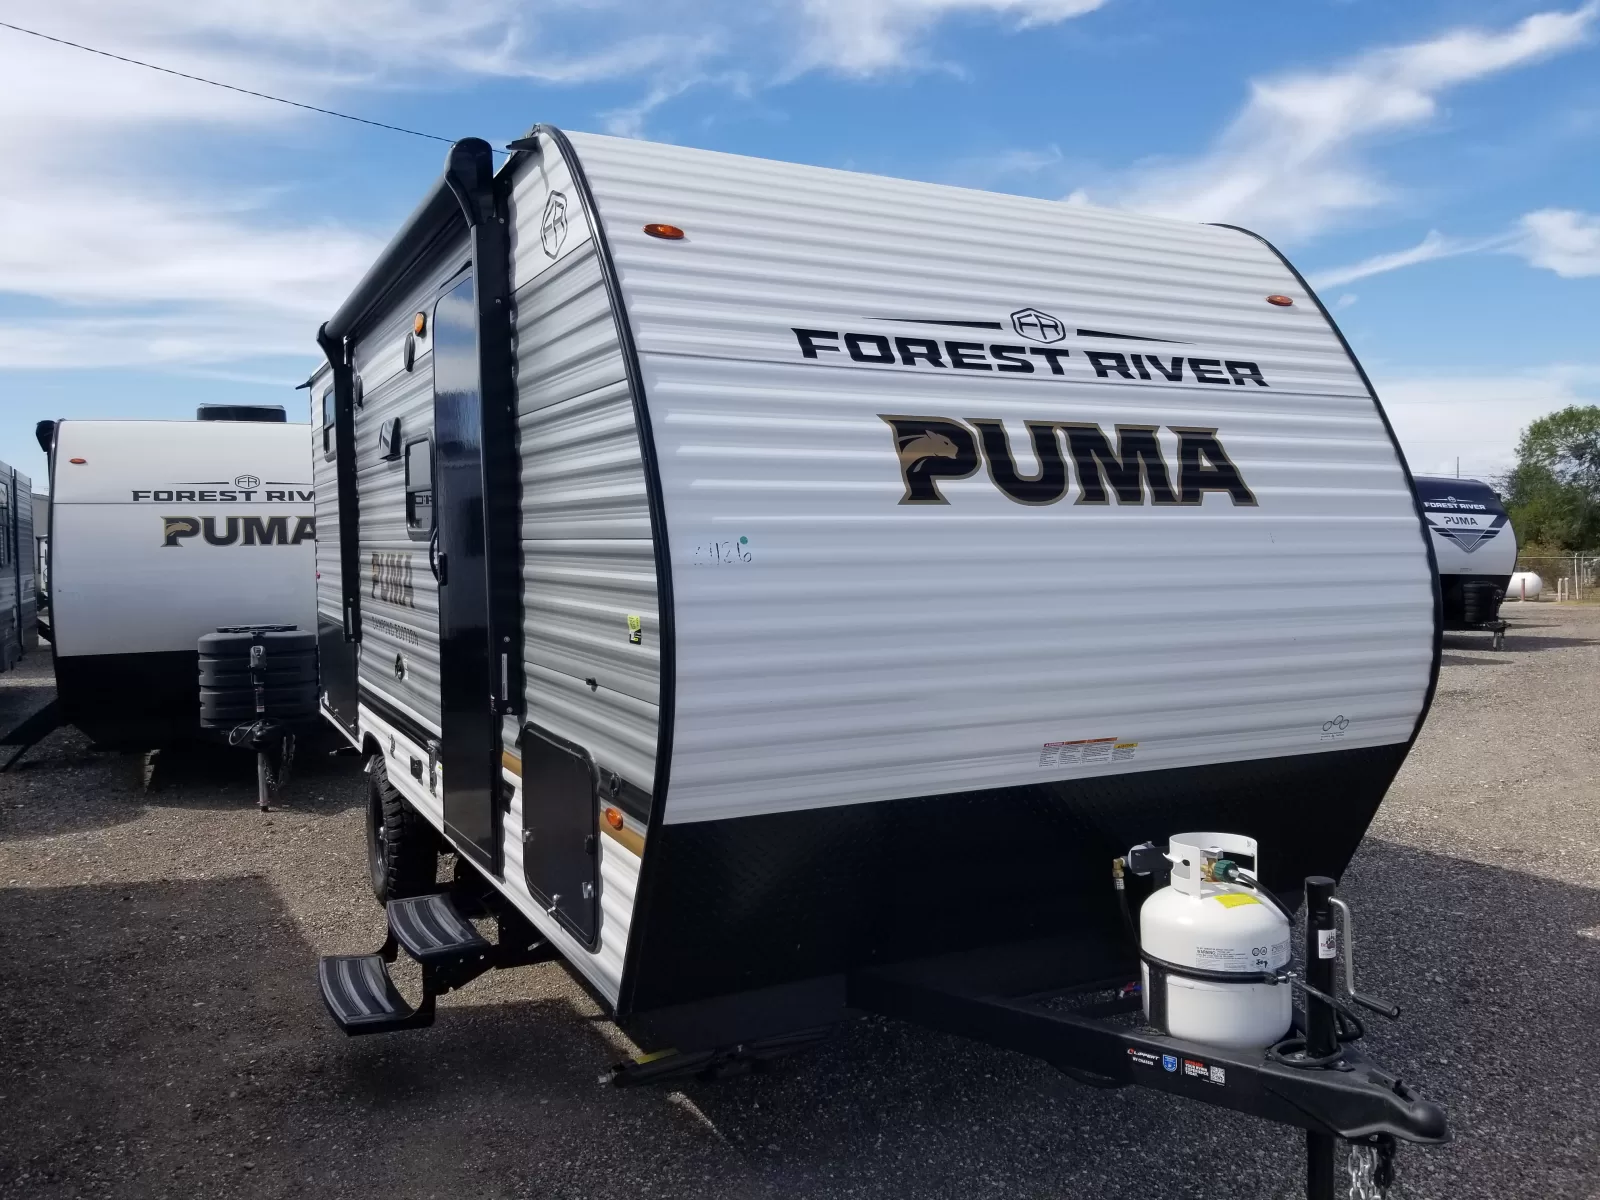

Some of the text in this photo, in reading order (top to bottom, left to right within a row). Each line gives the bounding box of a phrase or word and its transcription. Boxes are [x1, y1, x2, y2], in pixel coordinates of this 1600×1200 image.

[791, 327, 1270, 387] FOREST RIVER
[876, 413, 1260, 507] PUMA
[132, 490, 257, 501] FOREST
[1444, 516, 1478, 525] PUMA
[371, 553, 415, 608] PUMA
